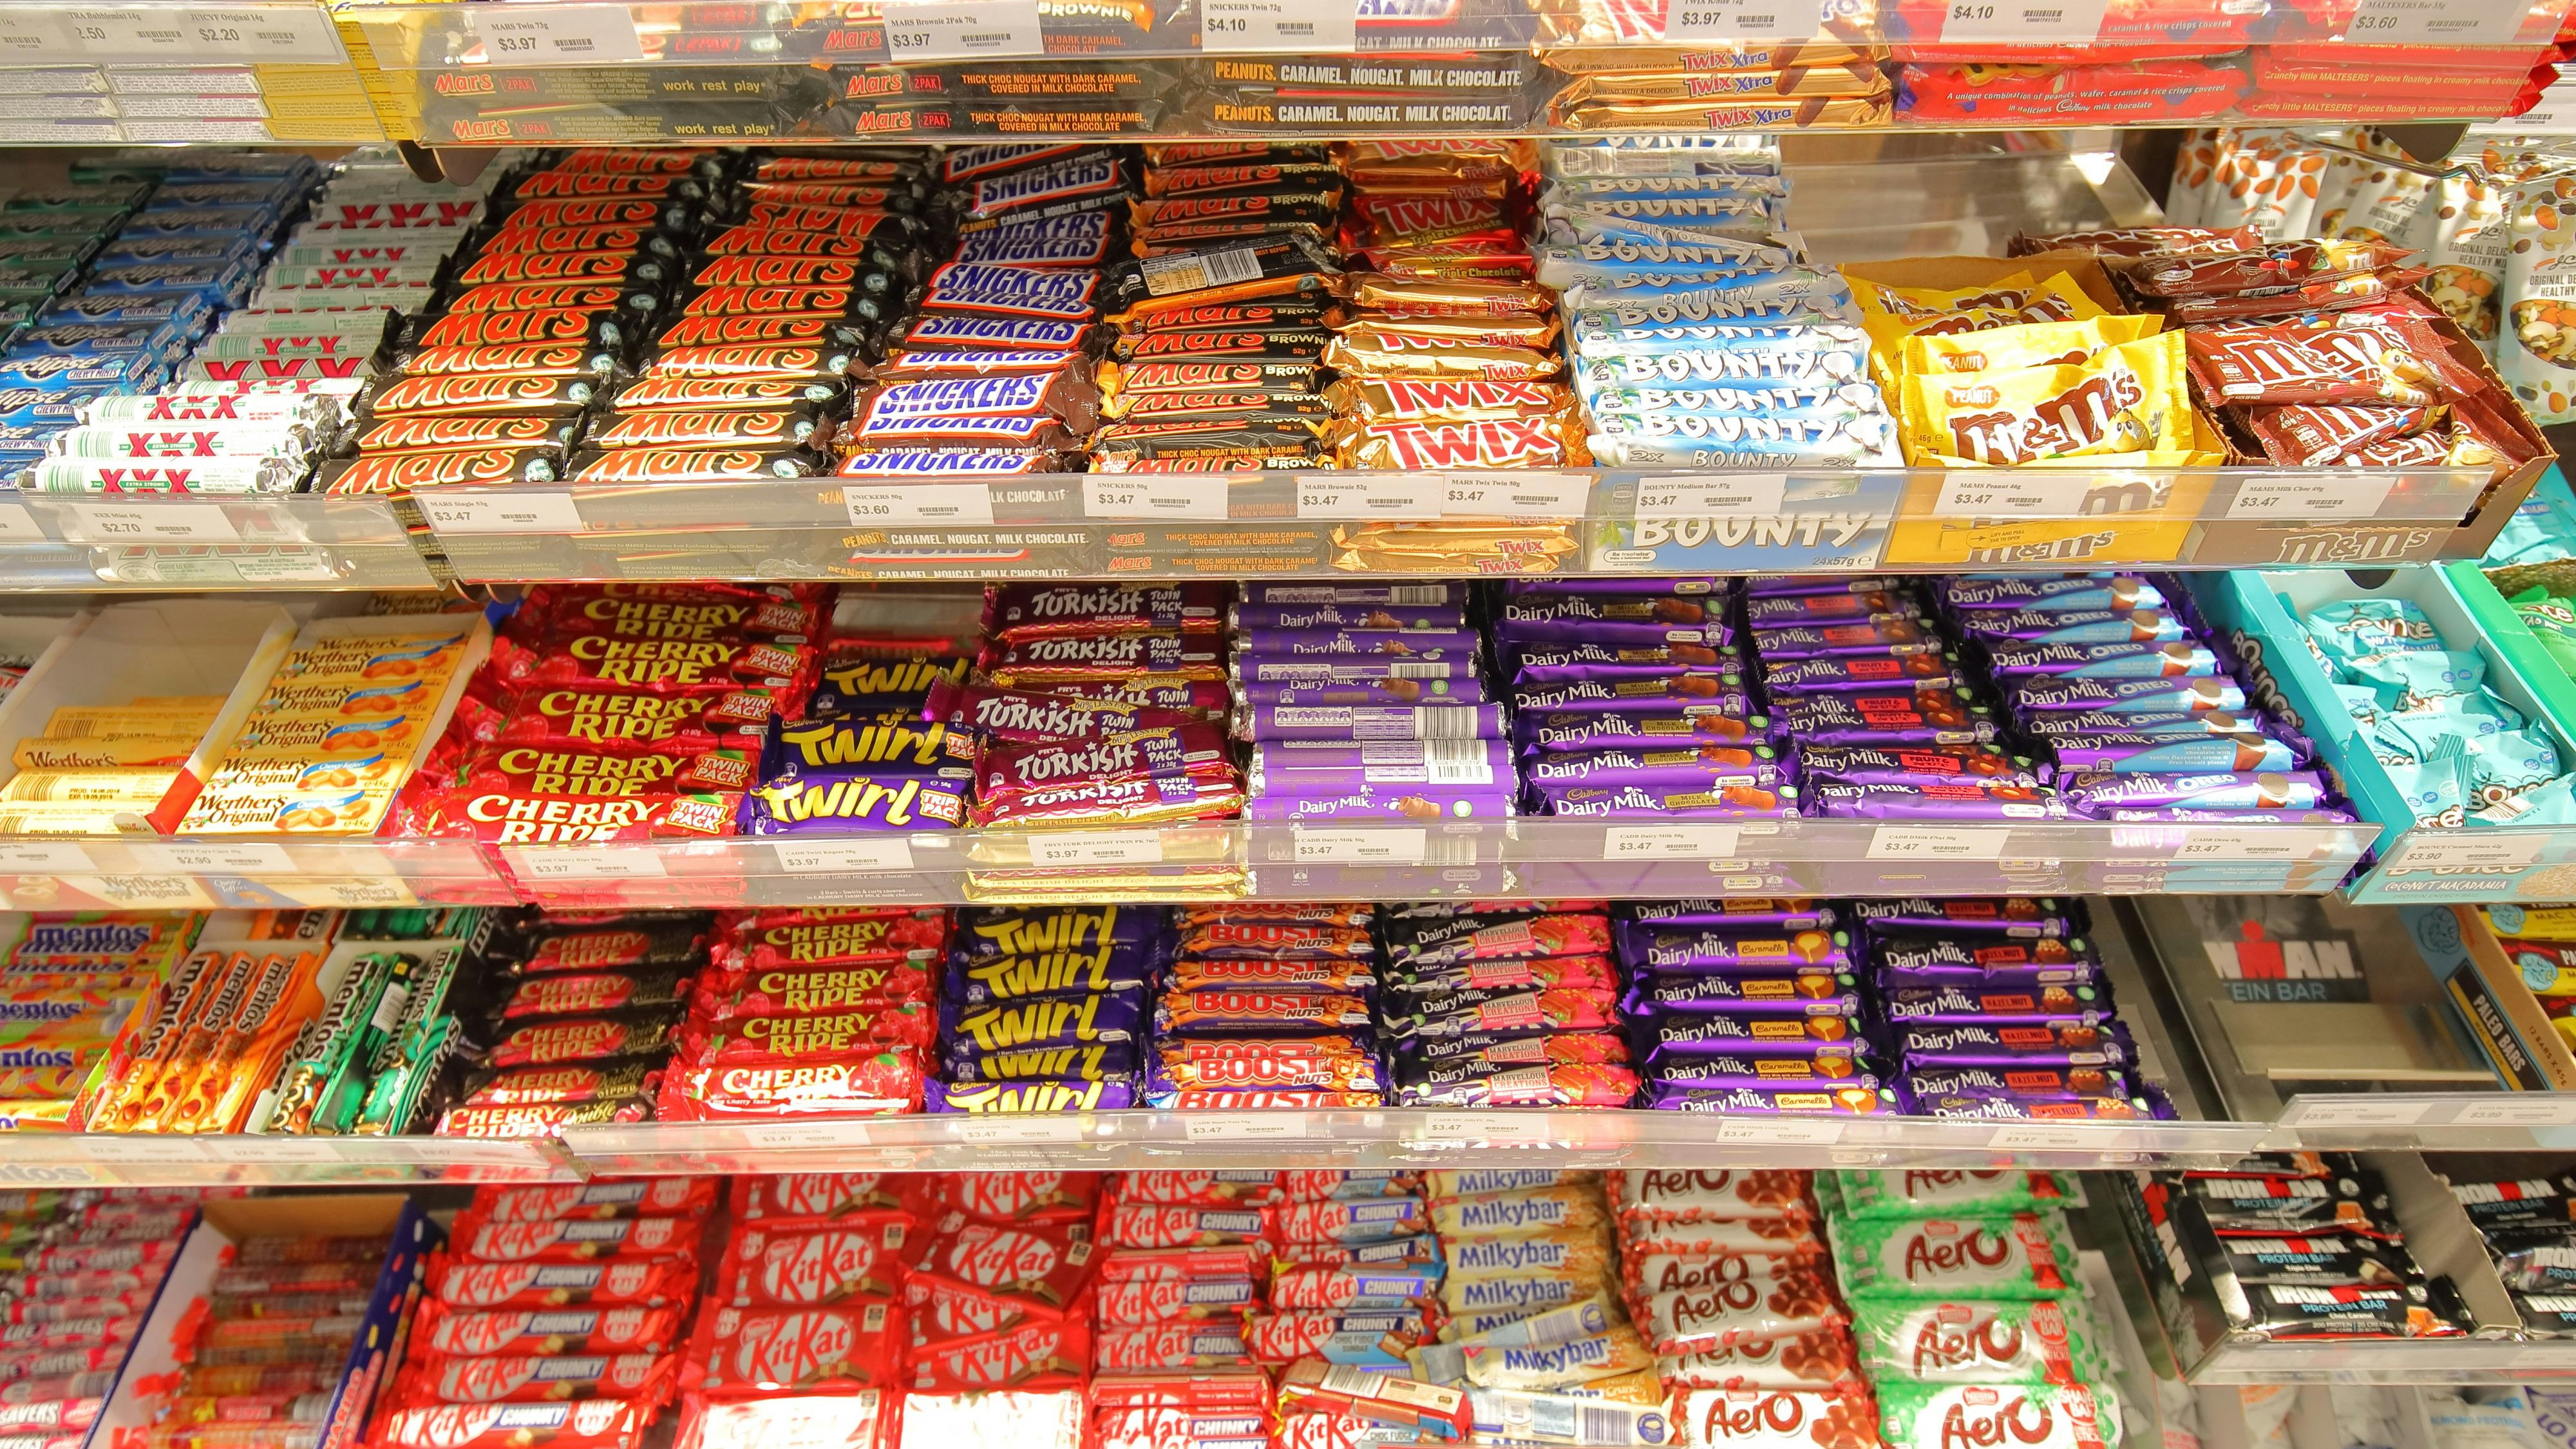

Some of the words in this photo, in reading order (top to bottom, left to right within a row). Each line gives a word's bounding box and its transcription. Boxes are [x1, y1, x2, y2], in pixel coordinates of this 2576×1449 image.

[1681, 12, 1720, 26] $3.97
[1953, 6, 1994, 20] $4.10
[891, 19, 914, 27] MARS
[965, 16, 978, 25] 70g
[1208, 19, 1245, 32] $4.10
[2356, 16, 2398, 29] $3.60
[199, 28, 240, 41] $2.20
[893, 33, 931, 48] $3.97
[498, 37, 537, 52] $3.97
[1730, 50, 1768, 67] Xtra
[962, 73, 987, 84] THICK
[989, 74, 1010, 84] CHOC
[1012, 74, 1048, 84] NOUGAT
[1049, 74, 1070, 84] WITH
[1072, 75, 1094, 84] DARK
[1097, 74, 1141, 84] CARAMEL,
[1215, 62, 1276, 80] PEANUTS.
[1281, 66, 1346, 84] CARAMEL.
[1350, 68, 1403, 86] NOUGAT.
[1410, 69, 1443, 86] MILK
[2265, 71, 2298, 82] Crunchy
[2300, 71, 2318, 80] little
[2374, 74, 2401, 84] pieces
[2403, 74, 2432, 85] floating
[2443, 77, 2472, 87] creamy
[2474, 76, 2490, 84] milk
[435, 73, 494, 95] Mars
[506, 80, 531, 90] 2PAK
[663, 80, 692, 91] work
[702, 81, 726, 91] rest
[847, 75, 902, 96] Mars
[914, 78, 938, 89] 2PAK
[991, 84, 1027, 93] COVERED
[1030, 84, 1039, 93] IN
[1042, 84, 1063, 93] MILK
[1065, 84, 1113, 93] CHOCOLATE
[2109, 89, 2141, 97] caramel
[2168, 86, 2192, 95] crisps
[2195, 84, 2226, 93] covered
[1754, 108, 1792, 126] Xtra
[694, 258, 857, 287] Mars
[1, 354, 100, 379] eclipse
[69, 370, 94, 379] CHEWY
[97, 368, 118, 377] MINTS
[1627, 351, 1819, 382] BOUNTY
[1129, 364, 1262, 389] Mars
[878, 375, 1046, 413] SNICKERS
[326, 450, 516, 497] Mars
[1718, 482, 1730, 491] 57g
[1099, 495, 1134, 504] $3.47
[1303, 495, 1338, 506] $3.47
[1448, 491, 1484, 501] $3.47
[1640, 495, 1677, 506] $3.47
[1955, 494, 1993, 504] $3.47
[2240, 497, 2279, 508] $3.47
[434, 511, 471, 521] $3.47
[853, 505, 890, 515] $3.60
[102, 522, 140, 533] $2.70
[1633, 511, 1874, 549] BOUNTY
[1812, 556, 1855, 568] 24x57g
[2021, 689, 2069, 706] Dairy
[2070, 683, 2115, 701] Milk
[2117, 681, 2172, 695] OREO
[539, 691, 715, 720] CHERRY
[728, 695, 772, 710] TWIN
[724, 705, 768, 720] PACK
[568, 715, 676, 744] RIPE
[781, 719, 945, 766] Twirl
[1144, 738, 1178, 752] TWIN
[1015, 743, 1139, 781] TURKISH
[1148, 750, 1182, 764] PACK
[1088, 769, 1133, 781] DELIGHT
[197, 795, 289, 815] Werther's
[1557, 799, 1612, 817] Dairy
[1615, 793, 1662, 811] Milk
[209, 808, 276, 824] Original
[1300, 846, 1332, 855] $3.47
[1619, 842, 1652, 851] $3.47
[1885, 843, 1919, 851] $3.47
[2184, 845, 2220, 853] $3.47
[178, 856, 211, 866] $2.90
[1046, 850, 1078, 858] $3.97
[2407, 852, 2442, 861] $3.90
[788, 858, 820, 866] $3.97
[536, 865, 569, 874] $3.97
[2385, 880, 2438, 891] COCONUT
[2440, 880, 2507, 891] MACADAMIA
[743, 1013, 875, 1039] CHERRY
[955, 995, 1099, 1051] Twirl
[1660, 1029, 1705, 1043] Dairy
[1707, 1021, 1745, 1038] Milk
[2472, 994, 2501, 1038] PALEO
[2497, 1032, 2526, 1074] BARS
[769, 1033, 850, 1057] RIPE
[1909, 1033, 1955, 1050] Dairy
[2005, 1030, 2047, 1041] HAZELNUT
[1199, 1056, 1325, 1081] BOOST
[1294, 1074, 1332, 1084] NUTS
[1493, 1072, 1546, 1082] MARVELLOUS
[1492, 1079, 1547, 1090] CREATIONS
[1461, 1200, 1564, 1227] Milkybar
[1119, 1206, 1193, 1246] KitKat
[1200, 1213, 1261, 1230] CHUNKY
[1906, 1227, 2007, 1282] Aero
[778, 1233, 869, 1302] KitKat
[2301, 1303, 2357, 1313] PROTEIN
[2360, 1300, 2387, 1310] BAR
[1706, 1390, 1802, 1445] Aero
